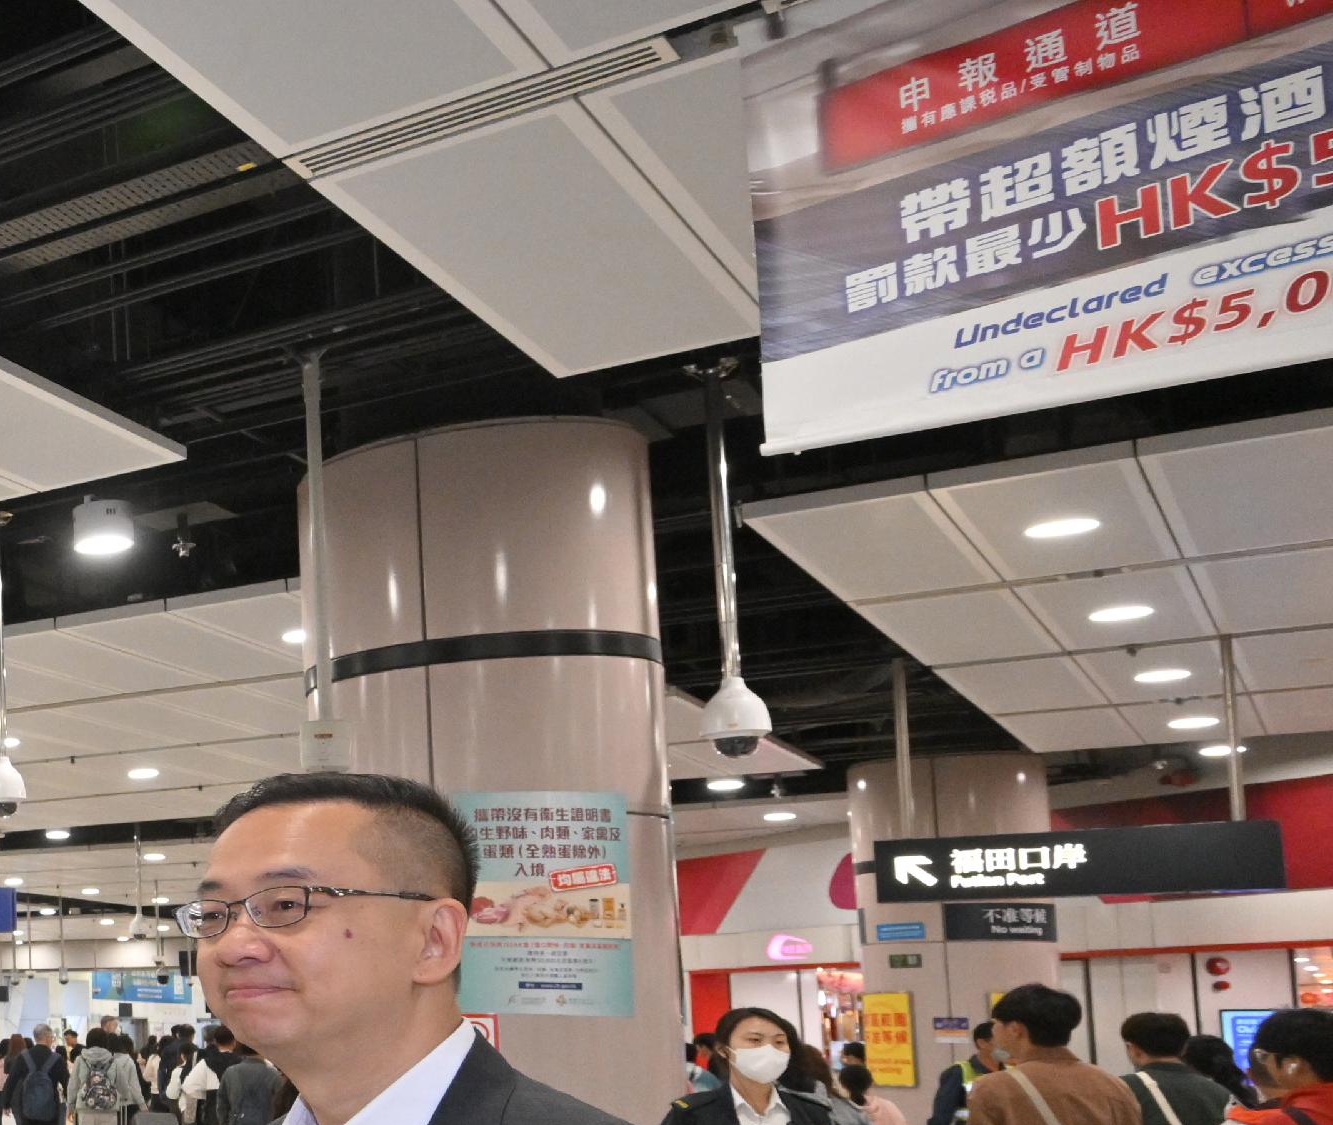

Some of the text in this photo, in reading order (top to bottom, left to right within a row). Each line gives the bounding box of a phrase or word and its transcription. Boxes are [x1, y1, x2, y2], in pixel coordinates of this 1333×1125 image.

[899, 2, 1141, 111] 申報通道
[900, 65, 1326, 243] 帶超額煙酒
[953, 273, 1169, 349] Undeclared
[930, 358, 1009, 393] from
[1020, 348, 1044, 370] a
[949, 844, 1088, 874] 福田口岸
